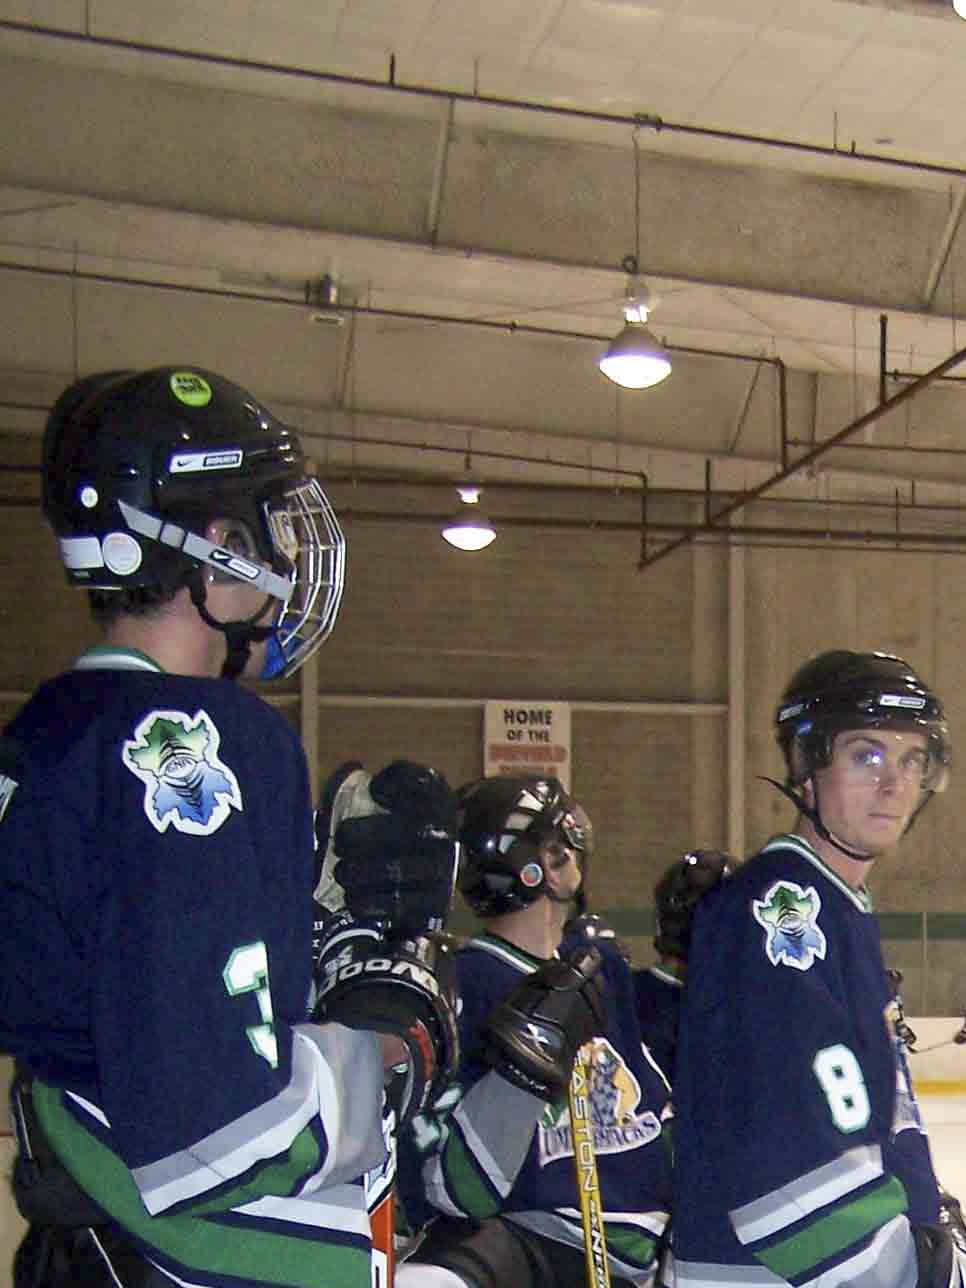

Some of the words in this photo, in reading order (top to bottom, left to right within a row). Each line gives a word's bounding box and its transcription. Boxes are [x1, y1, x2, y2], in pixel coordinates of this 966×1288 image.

[503, 709, 553, 725] HOME
[507, 729, 524, 742] OF
[528, 729, 549, 743] THE
[812, 1042, 872, 1134] 8
